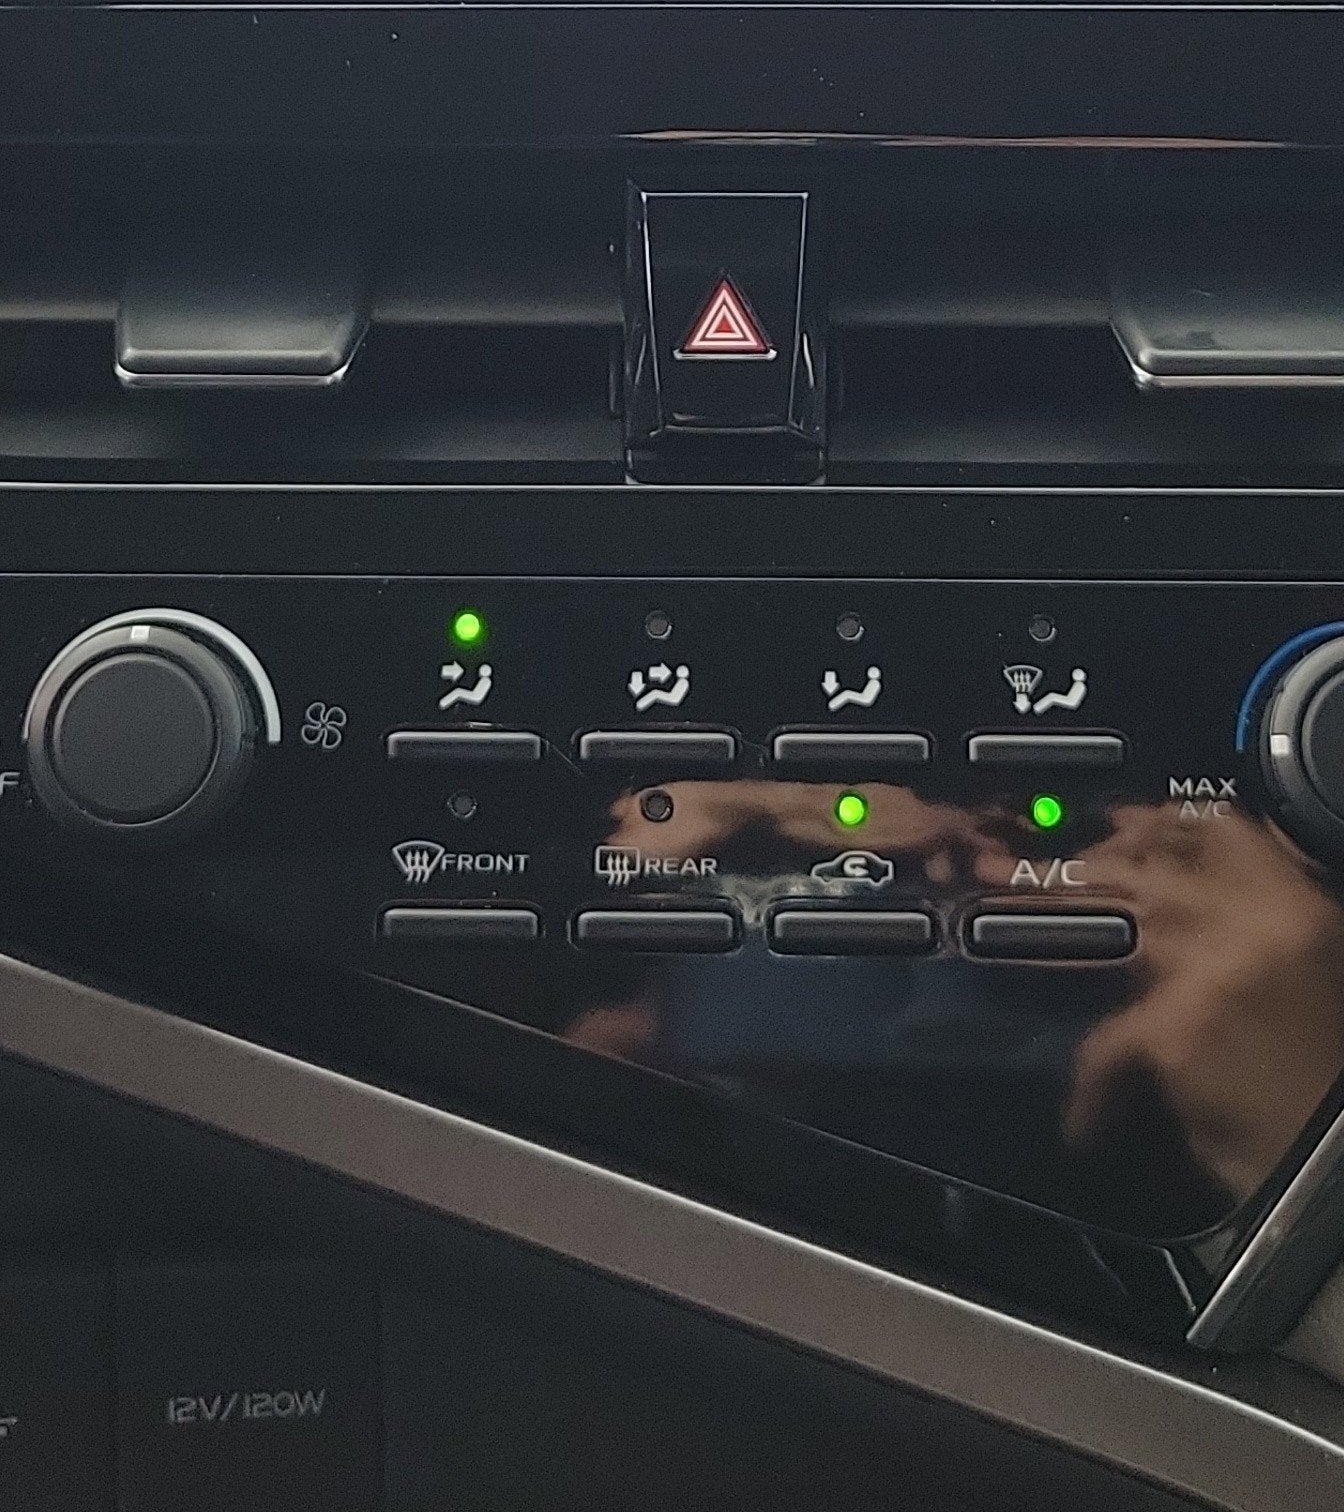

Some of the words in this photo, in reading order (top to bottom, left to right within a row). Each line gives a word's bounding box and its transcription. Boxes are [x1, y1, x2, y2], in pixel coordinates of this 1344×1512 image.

[1170, 778, 1236, 796] MAX
[441, 852, 529, 873] FRONT
[644, 856, 720, 879] REAR
[1010, 857, 1088, 886] A/C
[168, 1389, 325, 1424] 12V/120W
